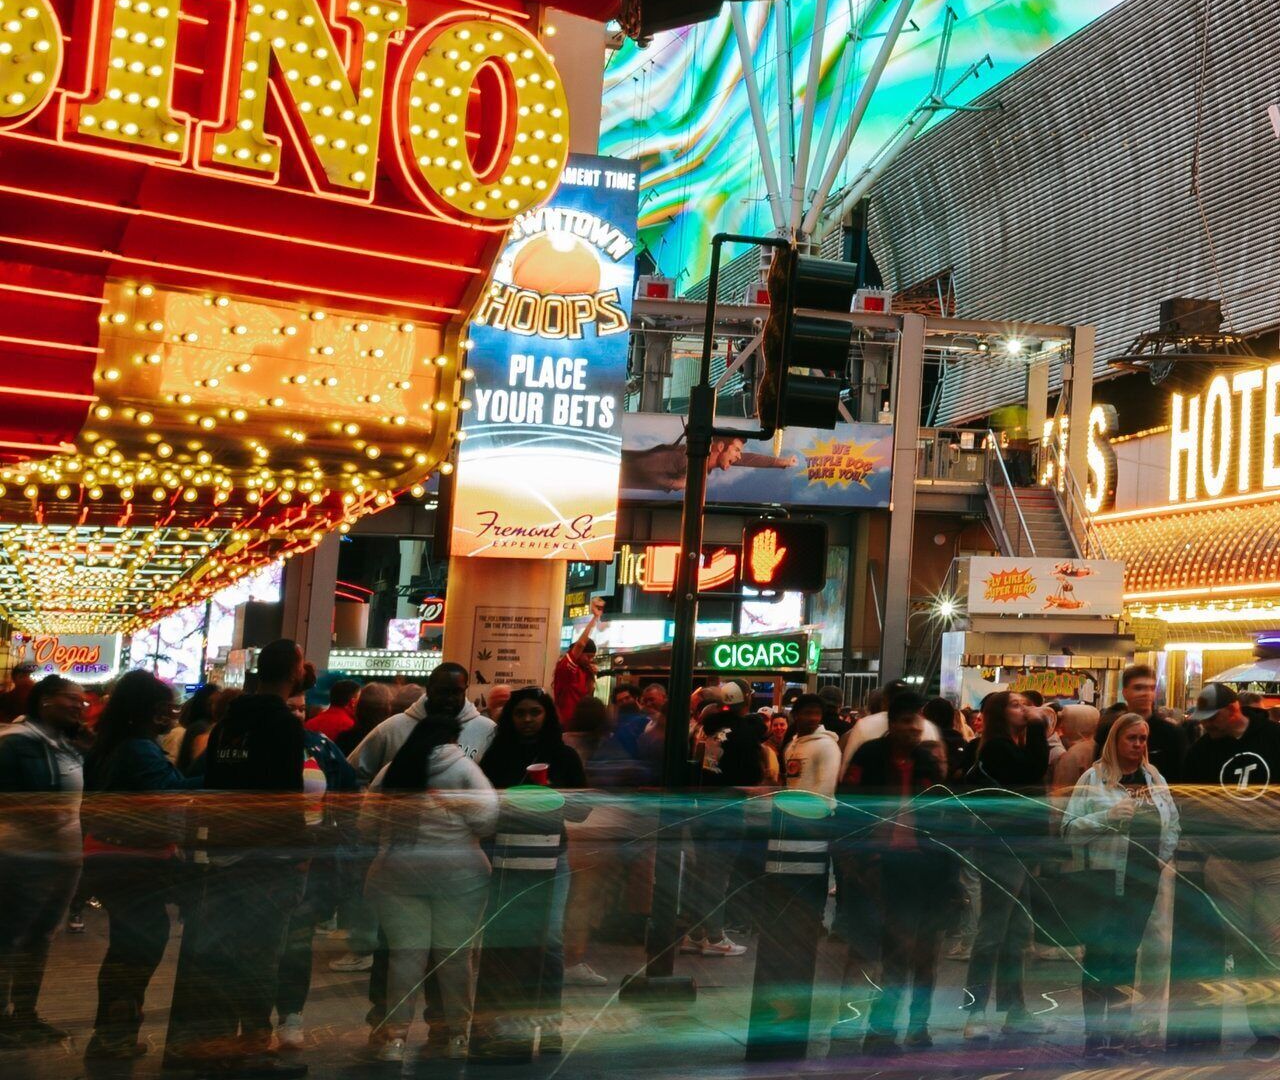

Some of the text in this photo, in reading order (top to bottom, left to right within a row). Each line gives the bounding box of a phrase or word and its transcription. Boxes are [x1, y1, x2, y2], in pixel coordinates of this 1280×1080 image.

[605, 170, 637, 191] TIME
[475, 281, 631, 340] HOOPS
[509, 354, 588, 391] PLACE
[475, 389, 615, 428] YOUR BETS
[832, 444, 851, 455] WE
[805, 455, 873, 472] TRIPLE DOG
[808, 467, 868, 483] DARE YOU!
[476, 511, 597, 540] Fremont St.
[493, 541, 577, 550] EXPERIENCE
[1004, 575, 1022, 585] LIKE
[1013, 582, 1037, 593] HERO
[33, 636, 100, 673] Vegas
[714, 642, 800, 668] CIGARS
[73, 664, 110, 673] GIFTS
[365, 658, 411, 669] CRYSTALS
